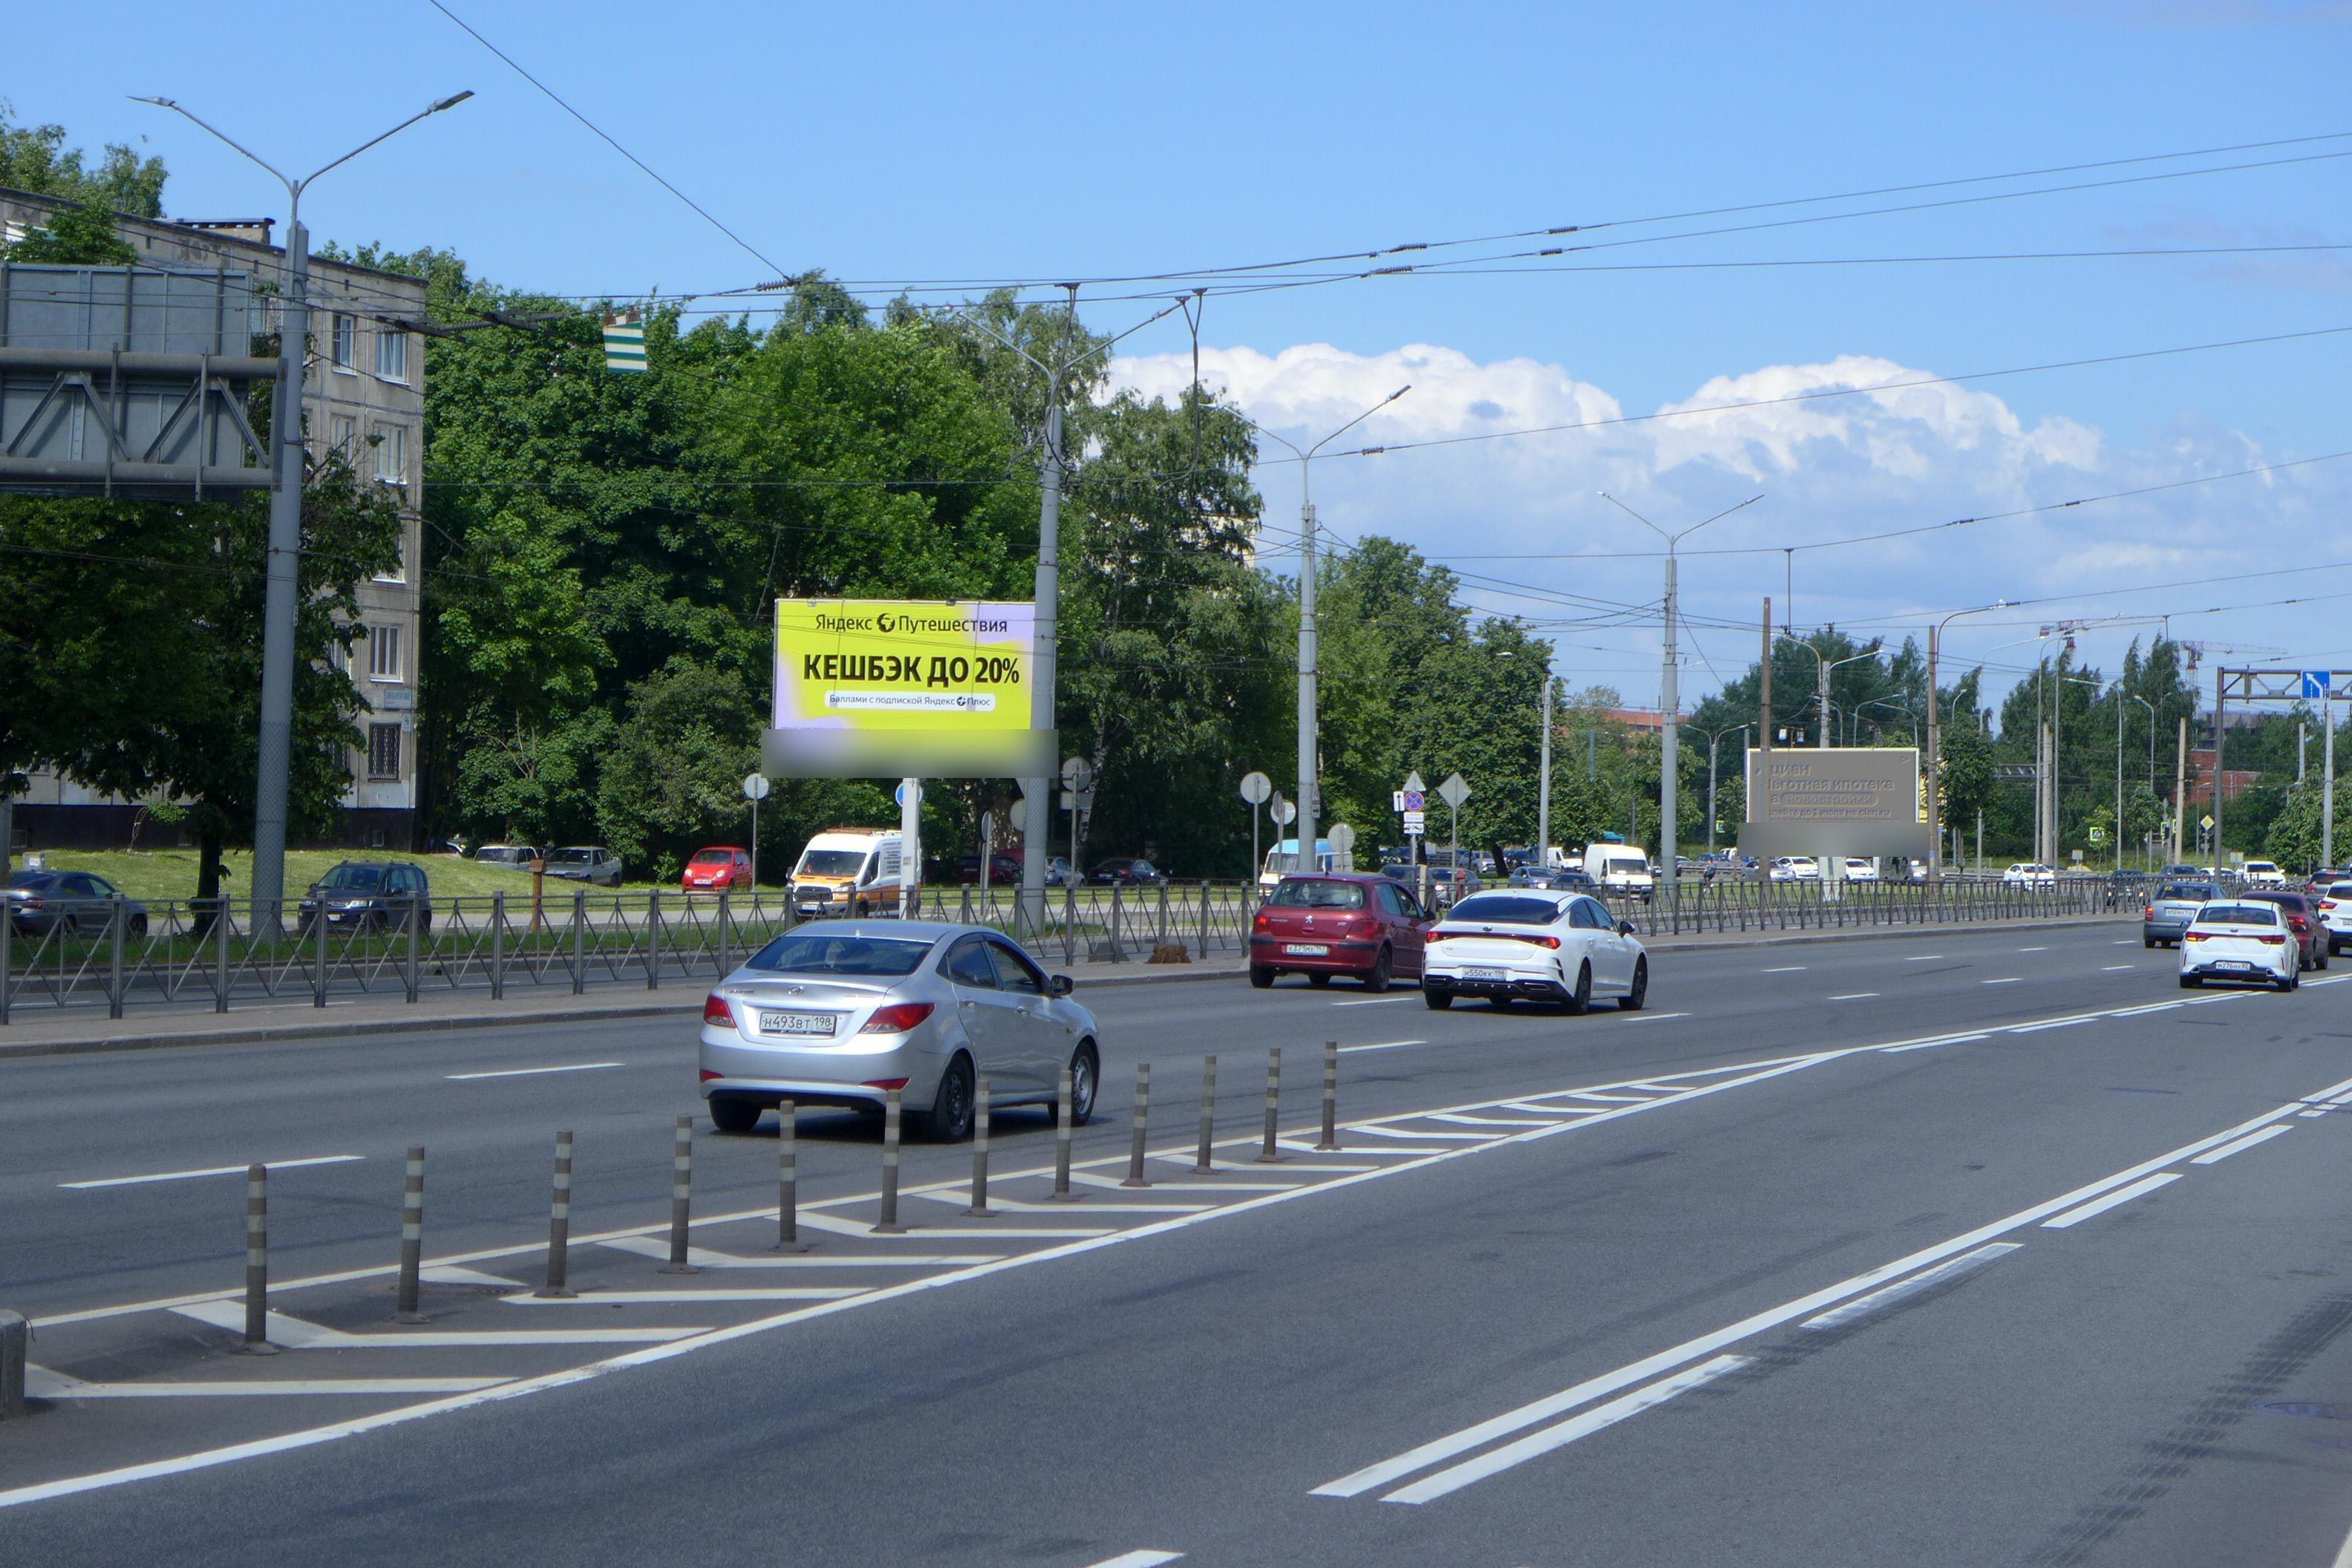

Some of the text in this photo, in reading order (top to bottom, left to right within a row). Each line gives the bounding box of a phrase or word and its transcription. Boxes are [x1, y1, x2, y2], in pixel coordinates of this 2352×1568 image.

[816, 614, 1007, 633] Яндекс Путешествия
[804, 654, 1019, 687] КЕШБЭК ДО 20%
[829, 695, 867, 703] Баллами
[875, 696, 921, 705] подпиской
[924, 696, 955, 706] Яндекс
[967, 697, 990, 706] Плюс
[1771, 764, 1811, 777] циан
[1832, 779, 1895, 790] ипотека
[1786, 794, 1872, 805] новостройки
[765, 1016, 832, 1029] Н493ВТ 198
